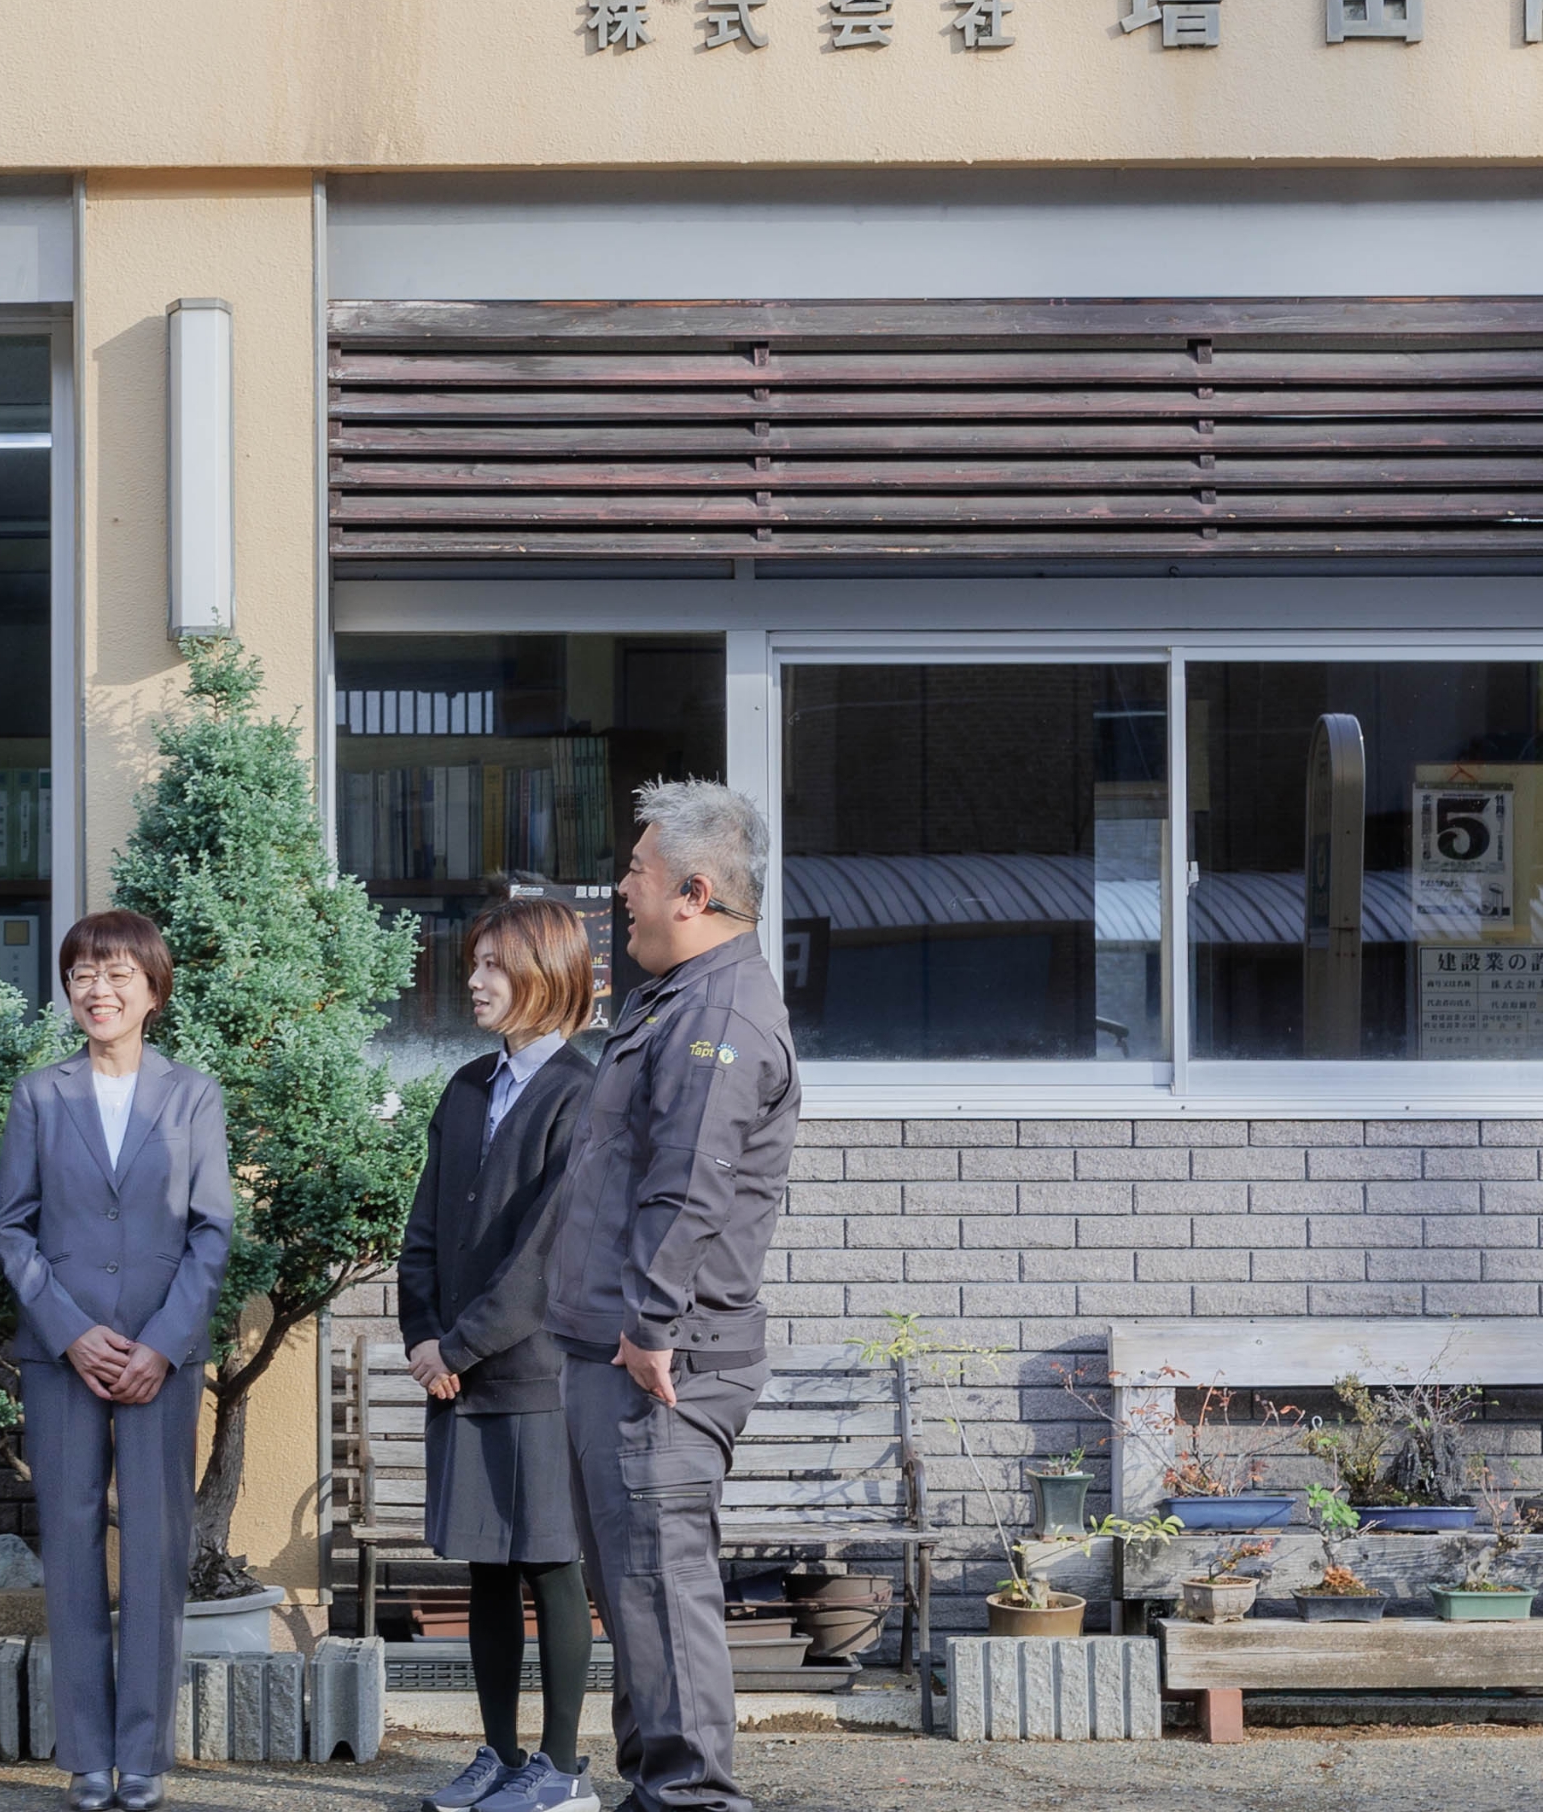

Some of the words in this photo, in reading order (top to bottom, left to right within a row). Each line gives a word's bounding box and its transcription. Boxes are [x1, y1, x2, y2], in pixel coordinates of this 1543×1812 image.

[1437, 798, 1490, 861] 5
[1491, 979, 1543, 989] 株式会社
